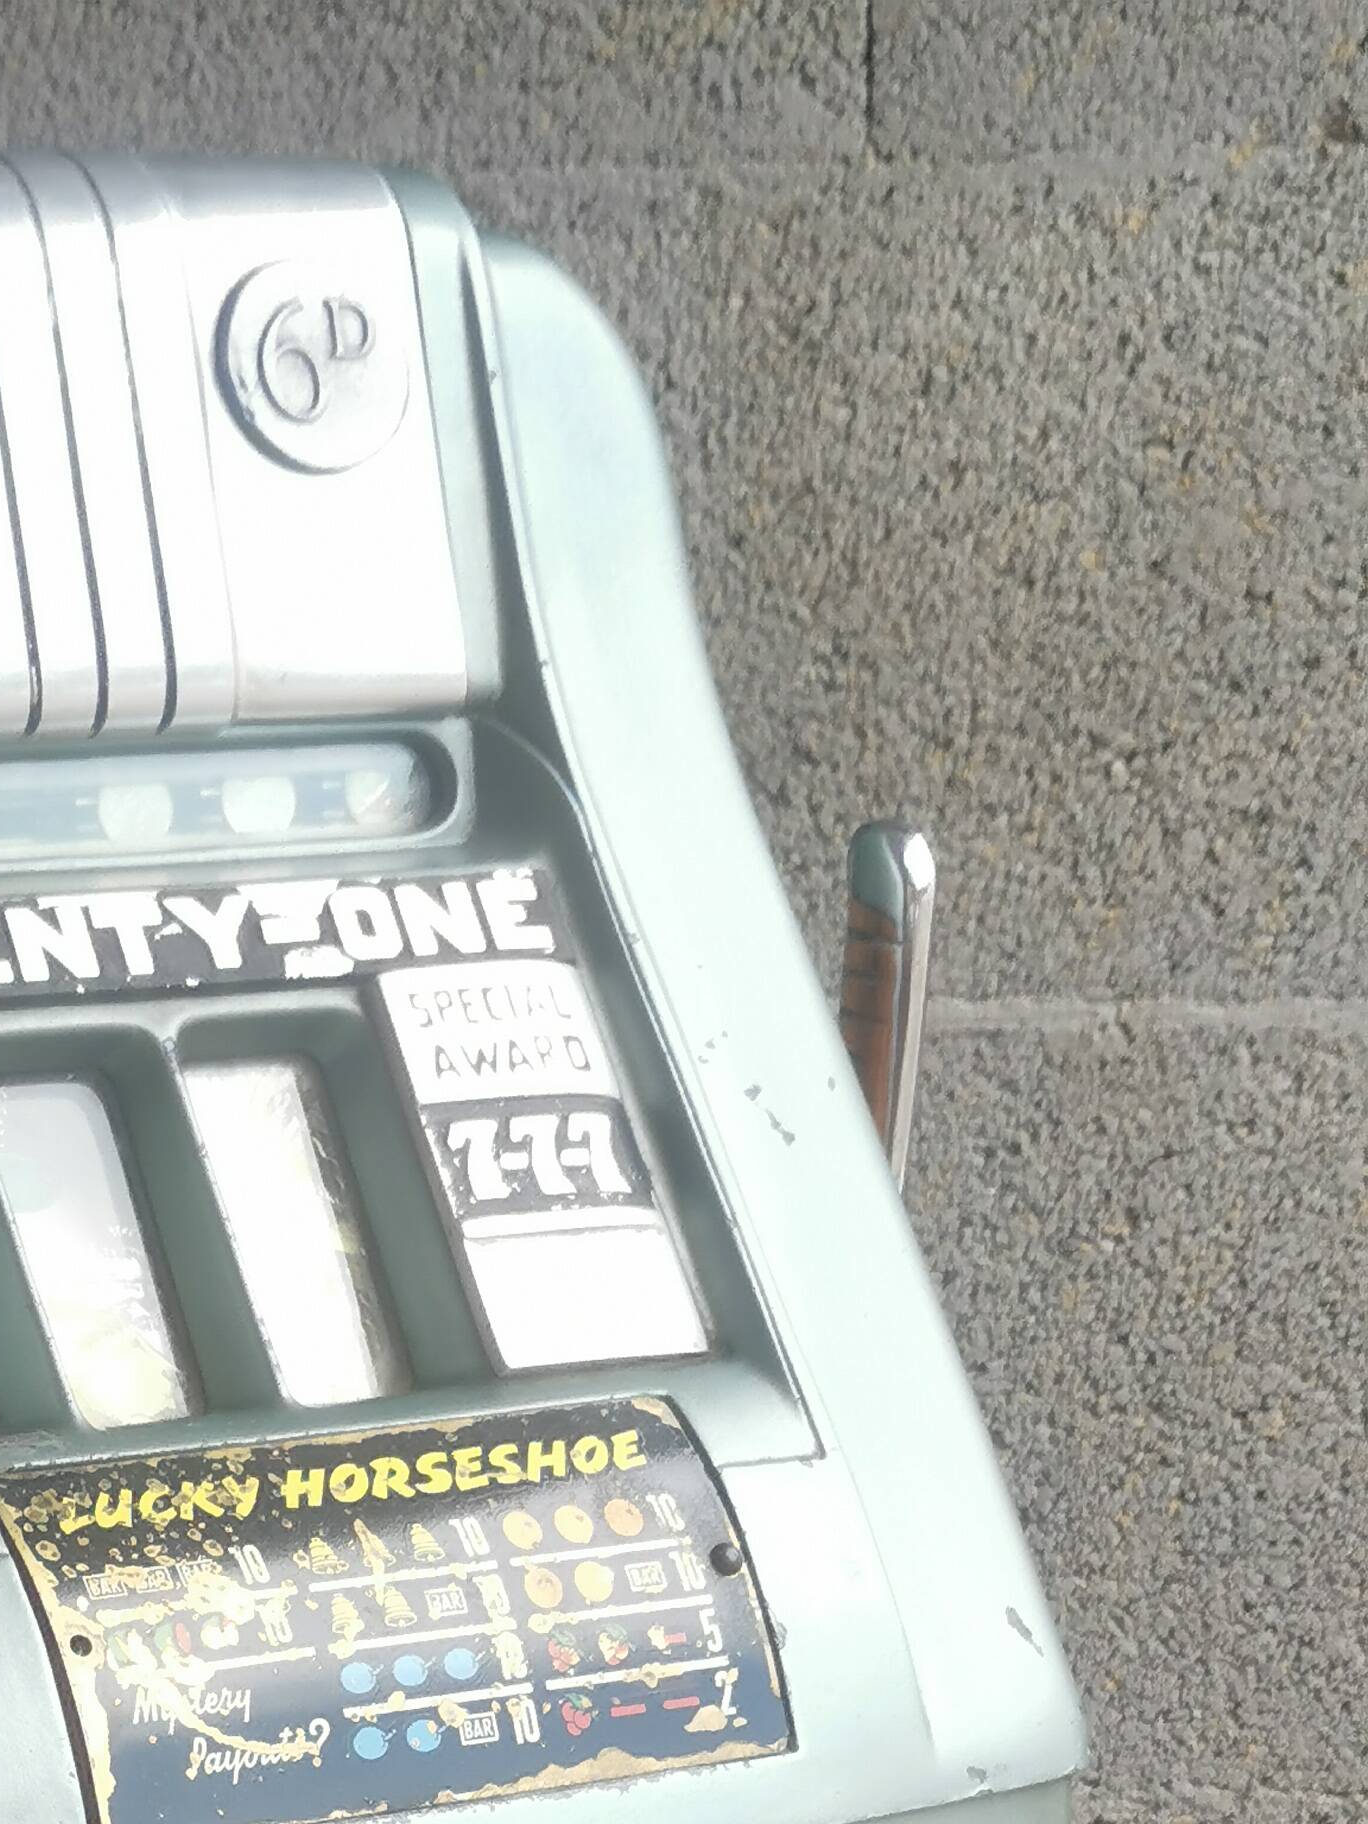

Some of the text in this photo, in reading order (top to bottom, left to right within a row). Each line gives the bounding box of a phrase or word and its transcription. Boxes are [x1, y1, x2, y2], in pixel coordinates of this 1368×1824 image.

[409, 985, 572, 1028] SPECIAL
[435, 1035, 586, 1079] AWARD
[59, 1429, 647, 1535] LUCKY HORSESHOE
[646, 1491, 685, 1531] 10
[449, 1515, 490, 1557] 10
[228, 1544, 271, 1585] 10
[429, 1589, 465, 1614] BAR
[699, 1607, 723, 1652] 5
[133, 1686, 251, 1735] Mytery
[462, 1697, 541, 1744] BAR 10
